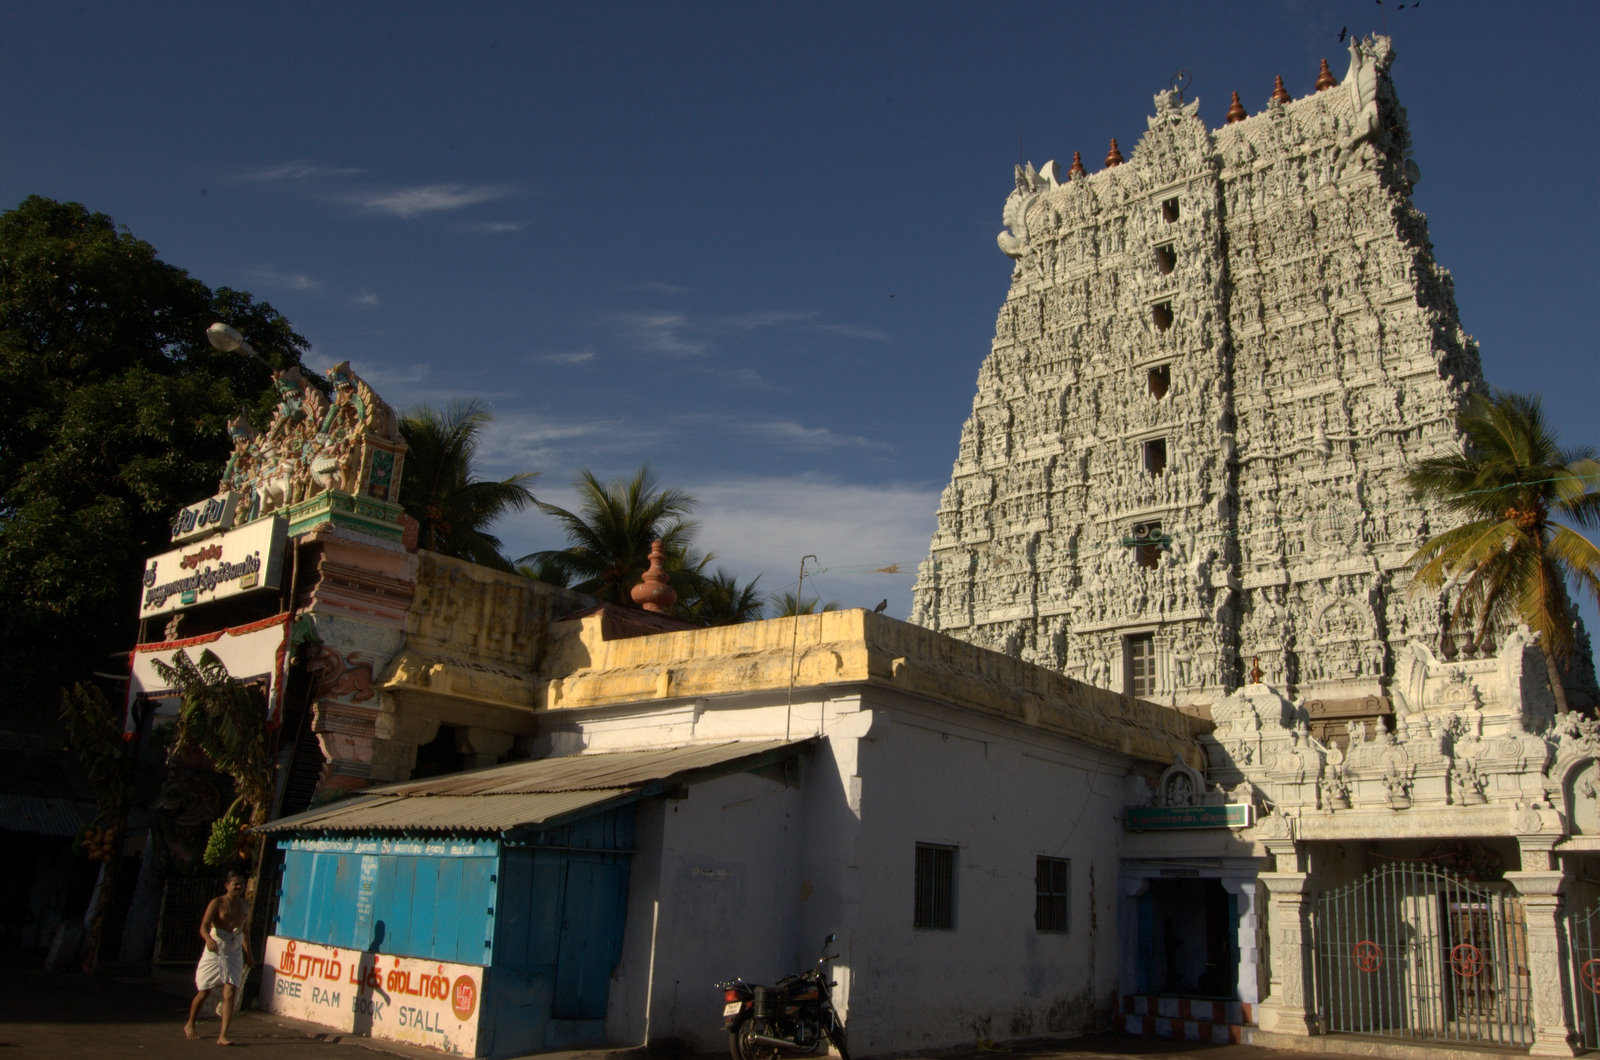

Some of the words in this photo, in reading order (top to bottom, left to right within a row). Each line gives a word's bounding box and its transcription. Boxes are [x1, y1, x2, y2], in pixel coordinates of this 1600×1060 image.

[276, 979, 302, 998] SREE
[312, 986, 340, 1008] RAM
[352, 996, 384, 1021] BOOK
[399, 1006, 445, 1034] STALL
